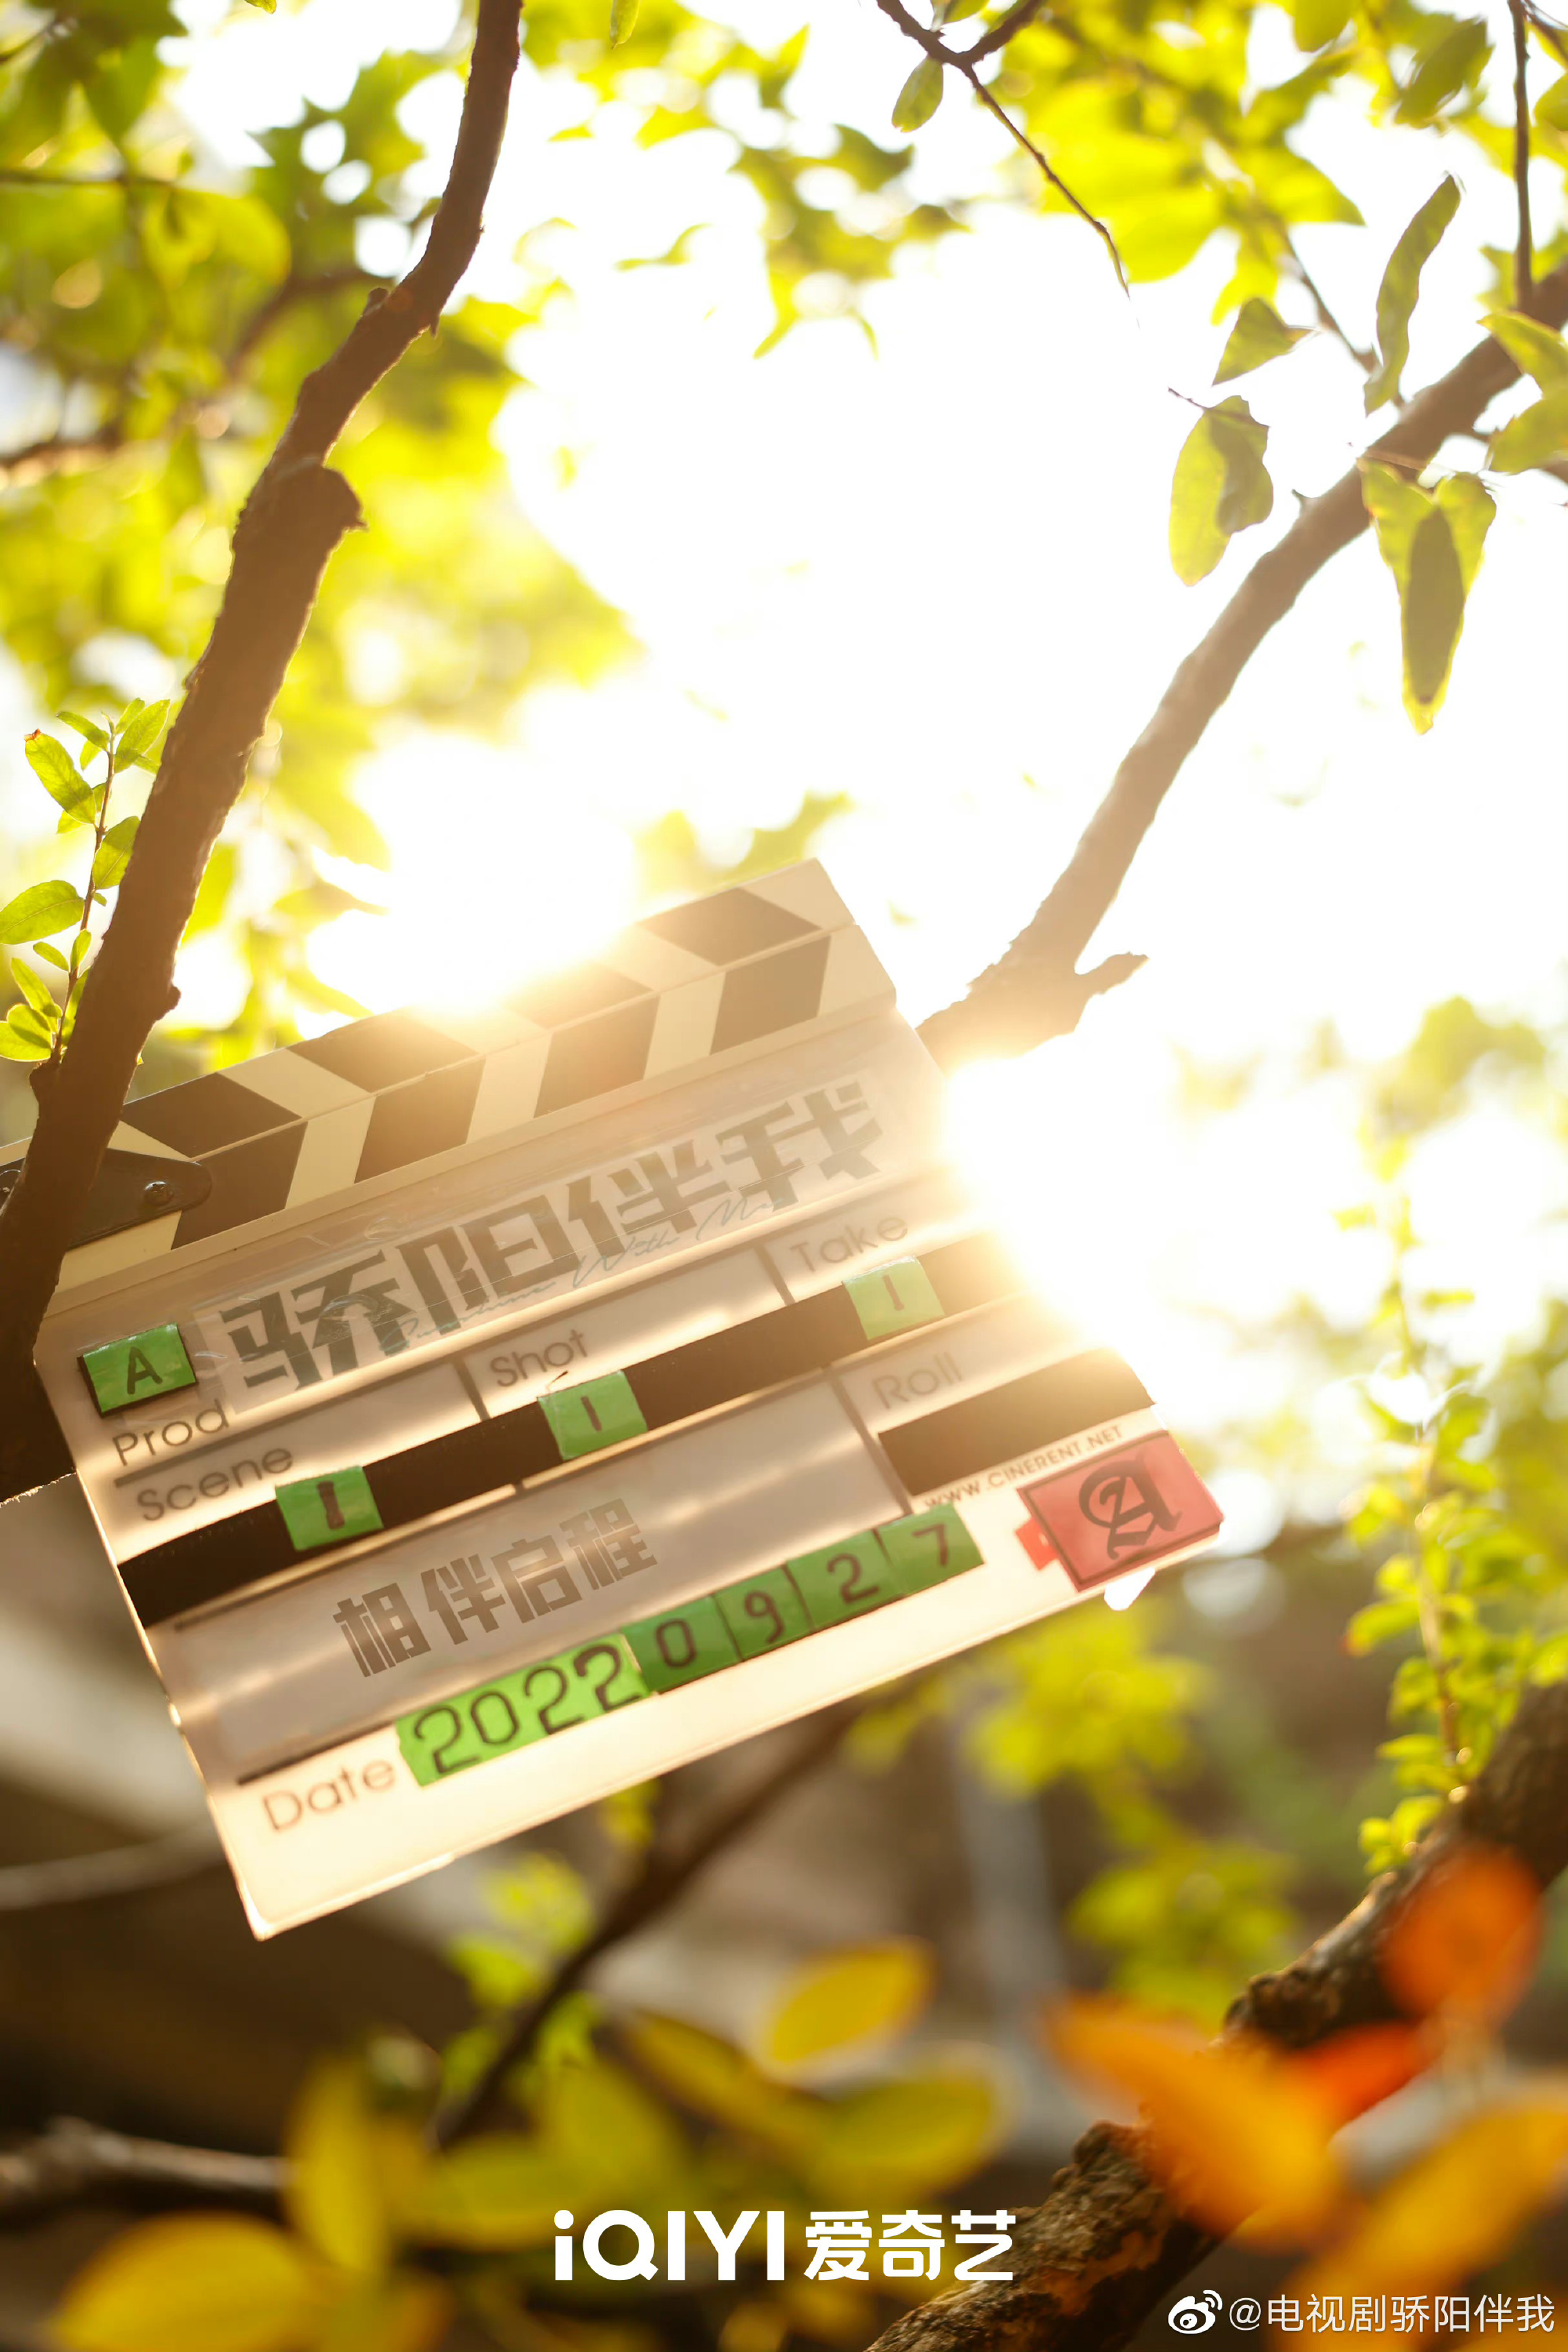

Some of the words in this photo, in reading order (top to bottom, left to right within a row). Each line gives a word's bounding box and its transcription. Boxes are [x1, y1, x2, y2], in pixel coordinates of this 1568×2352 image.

[219, 1080, 884, 1391] 骄阳伴我
[573, 1229, 680, 1289] With
[790, 1214, 908, 1272] Take
[126, 1345, 163, 1396] A
[489, 1329, 589, 1388] Shot
[871, 1350, 964, 1410] Roll
[111, 1398, 230, 1467] Prod
[136, 1446, 294, 1523] Scene
[332, 1497, 658, 1678] 相伴启程
[261, 1759, 397, 1833] Date
